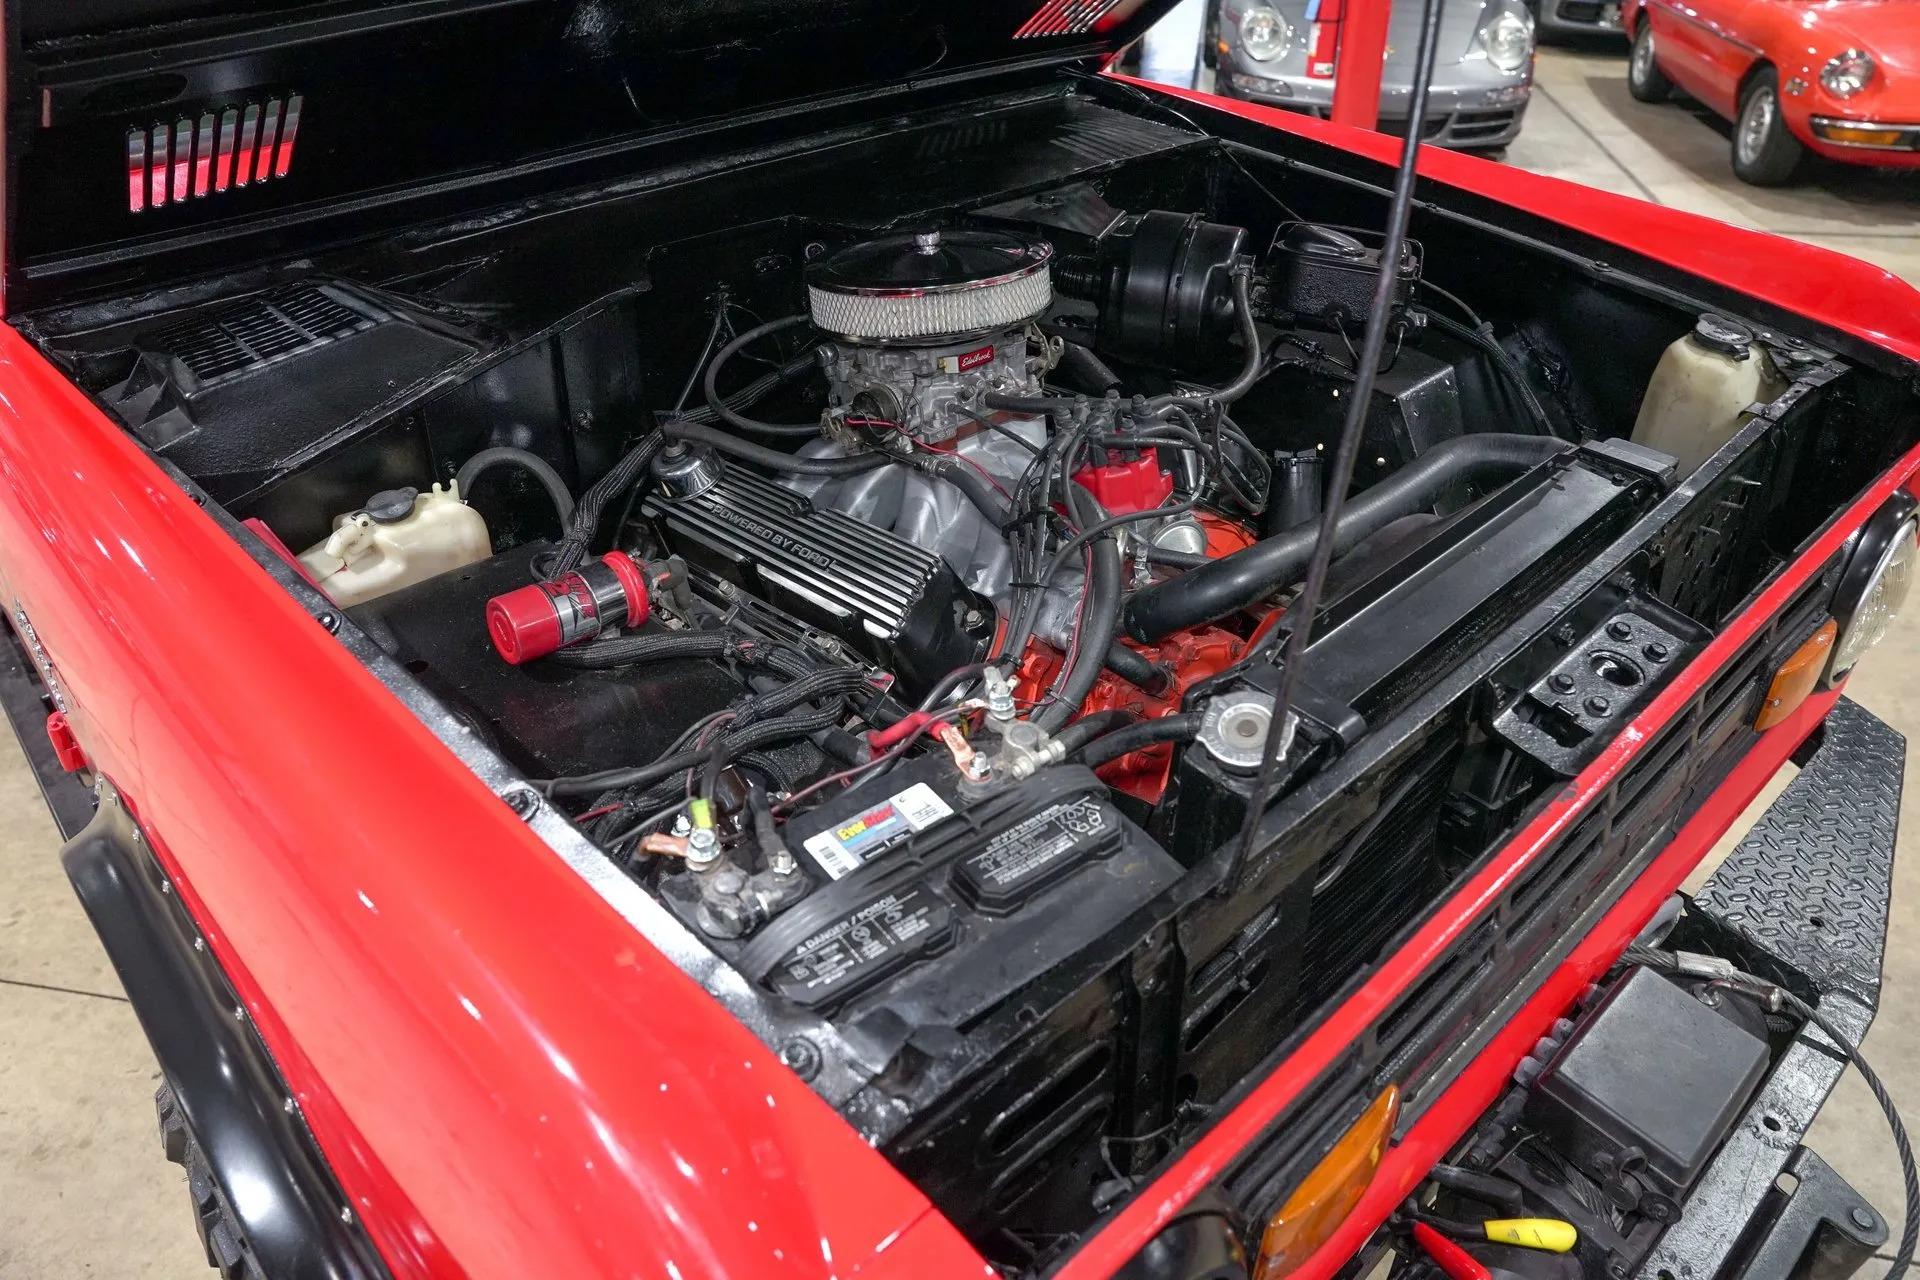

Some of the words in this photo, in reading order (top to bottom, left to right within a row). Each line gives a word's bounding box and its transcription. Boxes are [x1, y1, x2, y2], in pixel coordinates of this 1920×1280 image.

[961, 350, 991, 367] Edelbrock
[711, 503, 773, 540] POWERED
[771, 534, 793, 548] BY
[790, 543, 830, 567] FORD
[804, 920, 851, 949] DANGER
[856, 894, 898, 921] POISON
